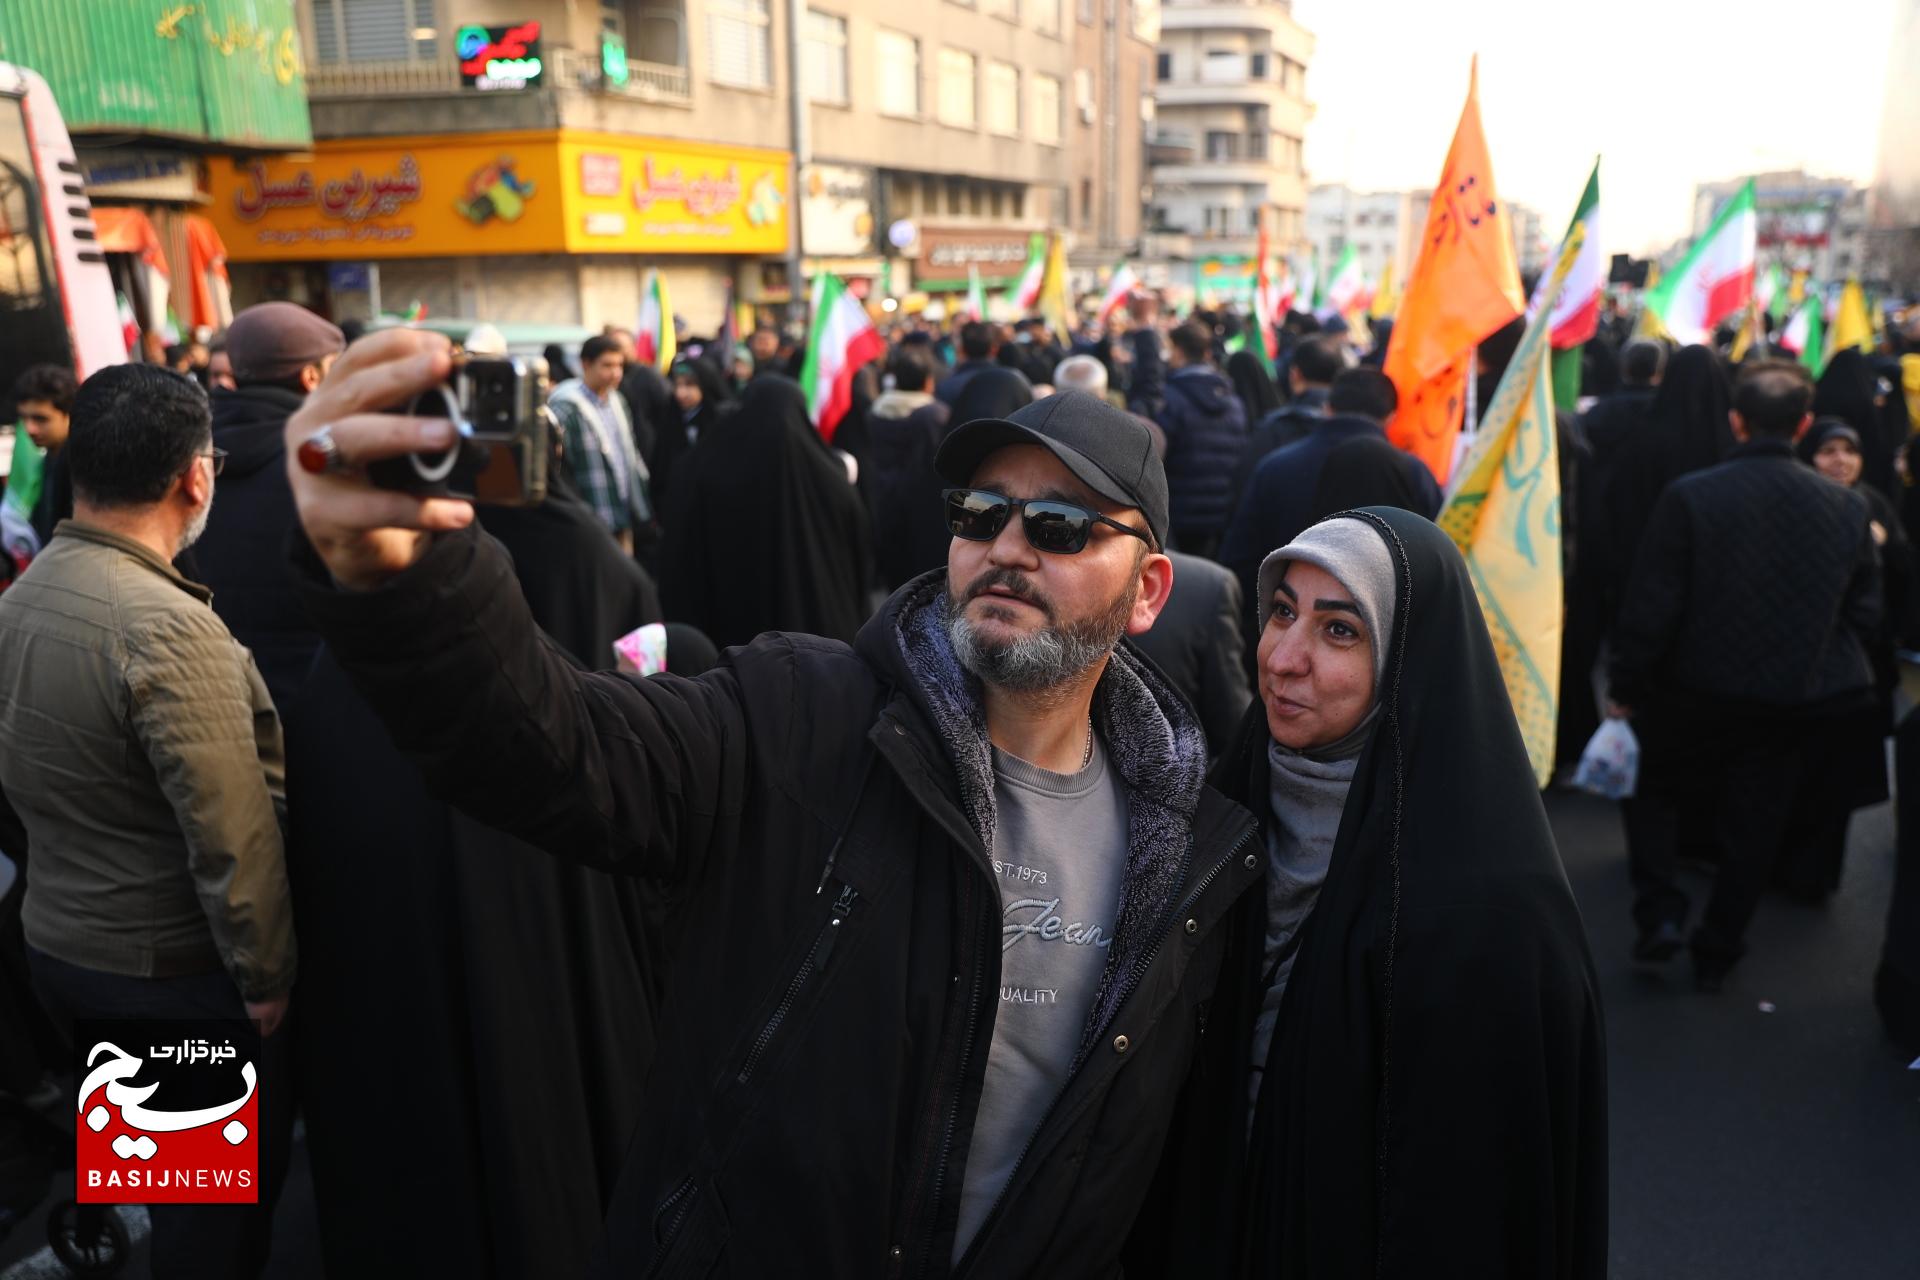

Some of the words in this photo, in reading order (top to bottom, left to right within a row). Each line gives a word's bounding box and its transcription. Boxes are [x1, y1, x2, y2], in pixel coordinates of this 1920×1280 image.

[235, 160, 314, 222] عسل
[323, 154, 420, 220] شیرین
[994, 861, 1048, 885] ST.1973
[1002, 898, 1114, 952] Jean
[1000, 987, 1058, 1004] UALITY
